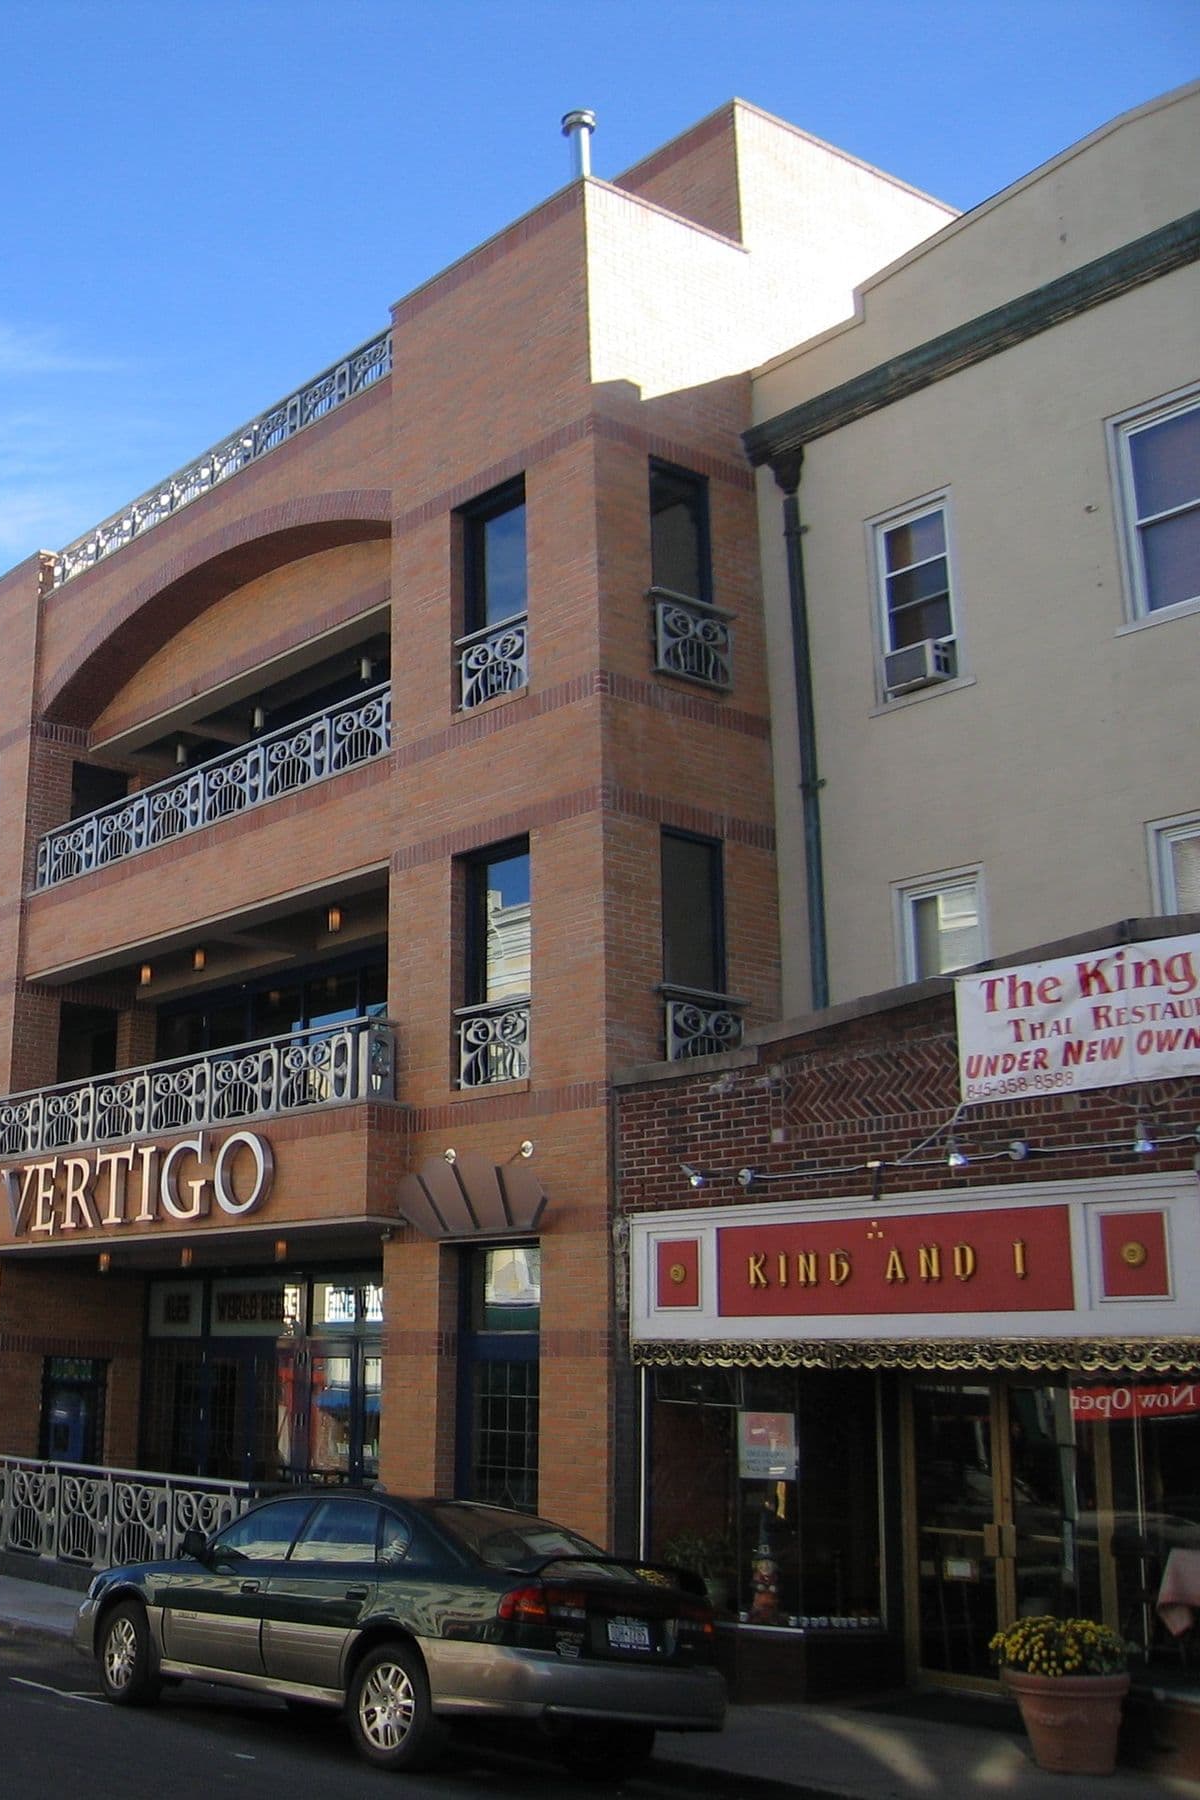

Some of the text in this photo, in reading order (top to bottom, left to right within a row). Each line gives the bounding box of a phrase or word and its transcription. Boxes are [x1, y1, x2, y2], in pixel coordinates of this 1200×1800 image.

[980, 951, 1198, 1014] The King
[1008, 1018, 1073, 1044] THAI
[966, 1048, 1049, 1079] UNDER
[1062, 1036, 1125, 1067] NEW
[1, 1130, 275, 1237] VERTIGO
[748, 1238, 1027, 1288] KING AND I
